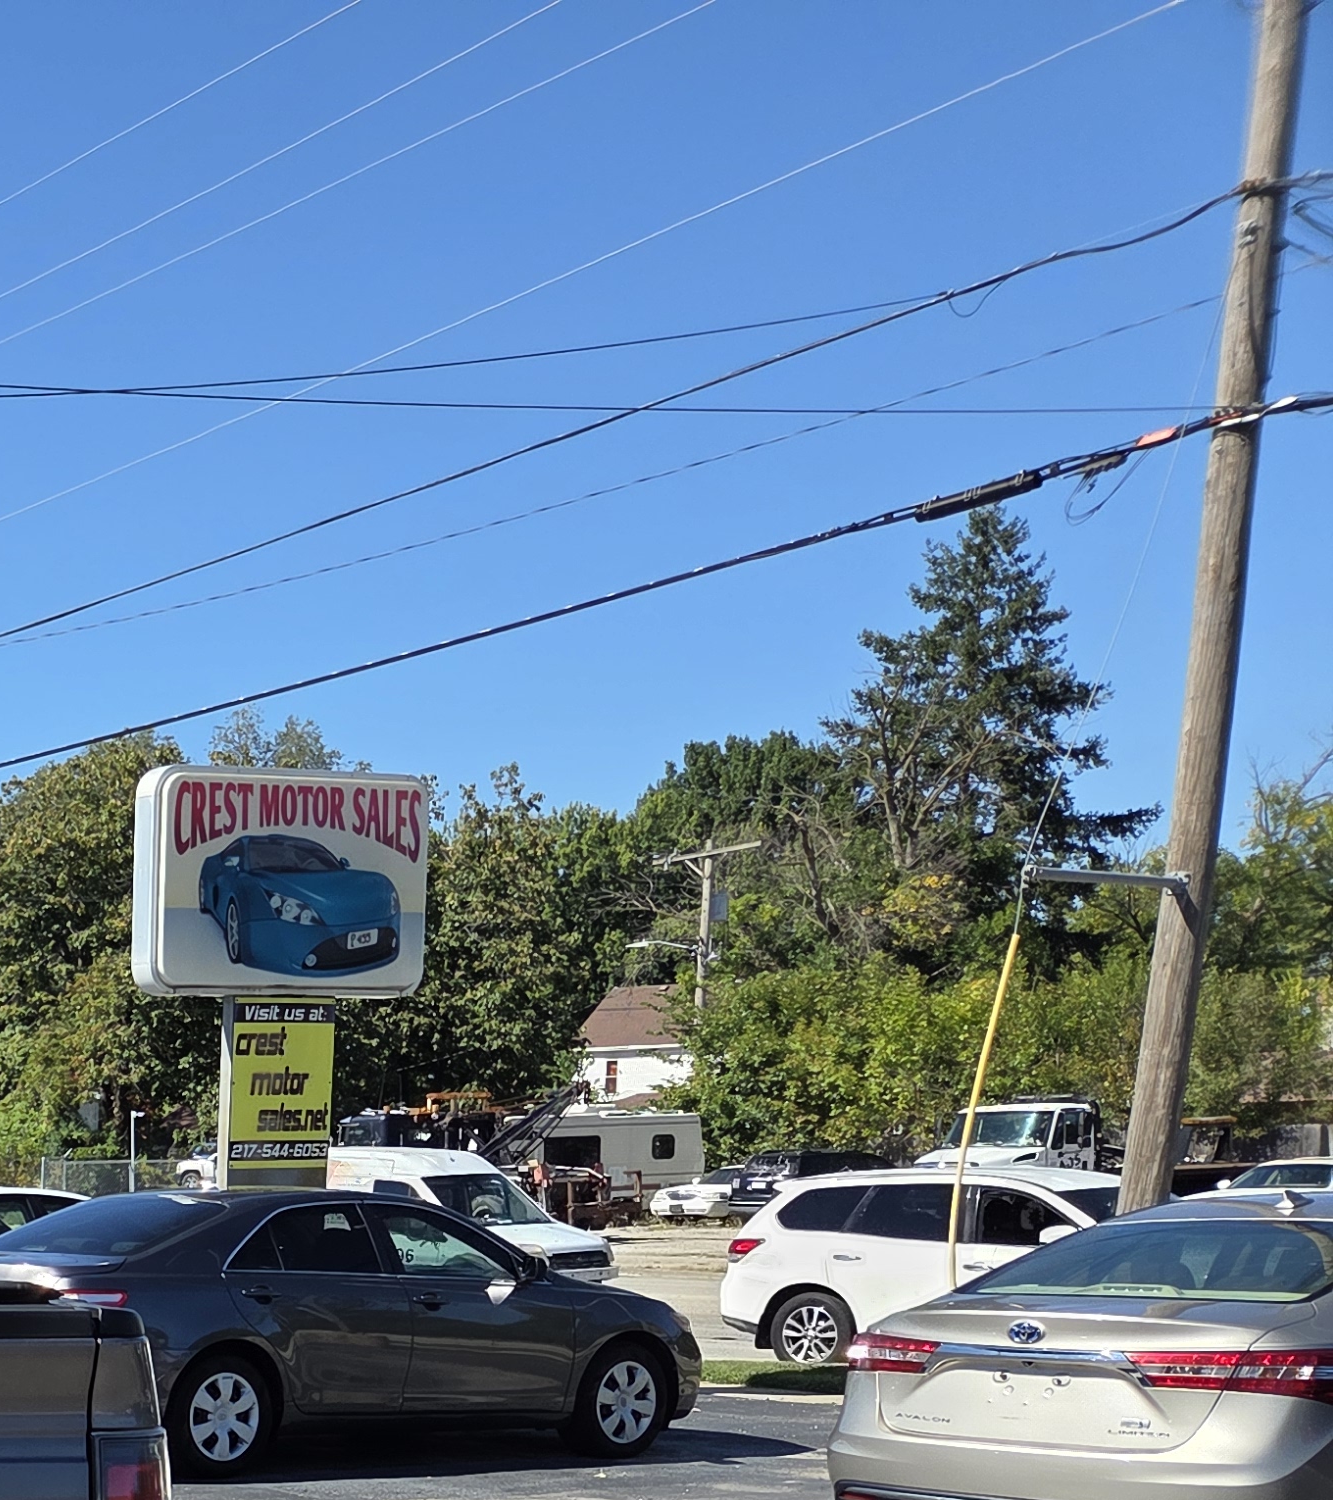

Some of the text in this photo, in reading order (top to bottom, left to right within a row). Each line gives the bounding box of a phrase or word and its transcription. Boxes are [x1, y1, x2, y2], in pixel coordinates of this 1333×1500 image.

[174, 780, 422, 863] CREST MOTOR SALES
[245, 1005, 328, 1021] Visit us at:
[235, 1026, 287, 1056] crest
[250, 1066, 309, 1096] motor
[257, 1102, 329, 1132] sales.net
[230, 1143, 329, 1159] 217-544-6053
[895, 1412, 951, 1424] AVALON
